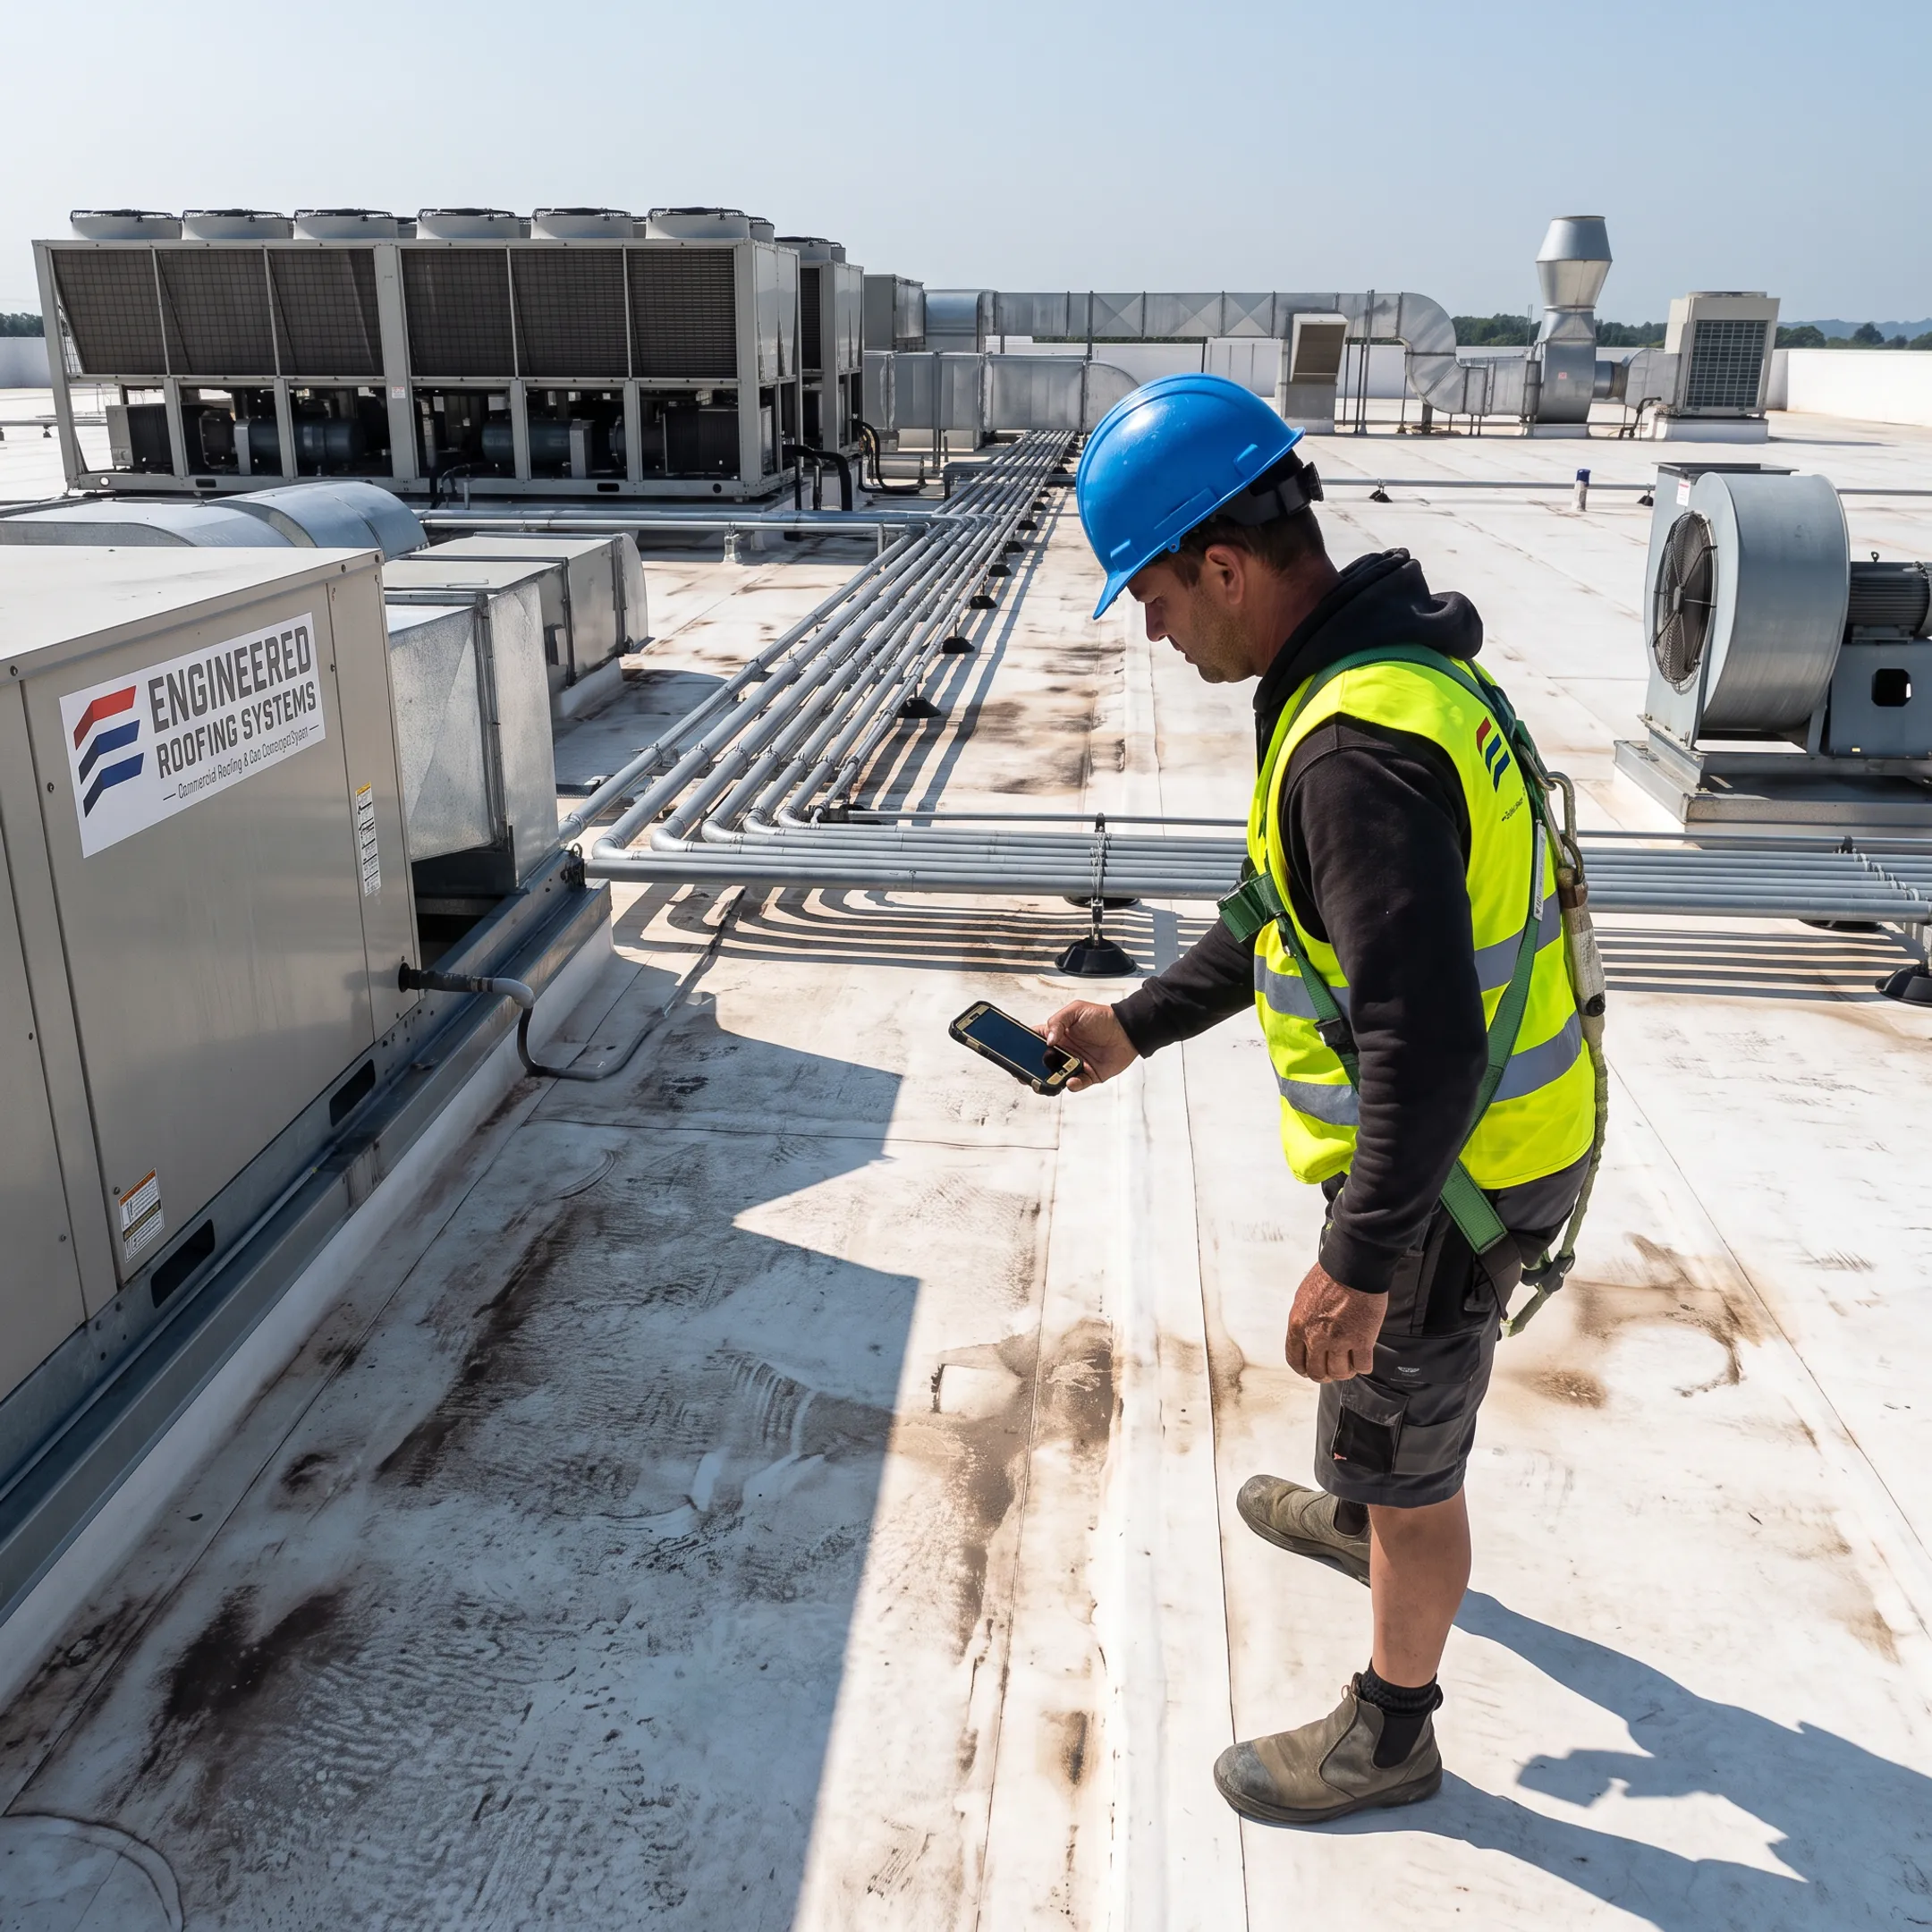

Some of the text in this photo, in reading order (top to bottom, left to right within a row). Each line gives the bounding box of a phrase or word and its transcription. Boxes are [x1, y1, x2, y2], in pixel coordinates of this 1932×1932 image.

[148, 625, 311, 733] ENGINEERED
[156, 714, 238, 779] ROOFING
[241, 681, 317, 740] SYSTEMS
[243, 752, 249, 767] &
